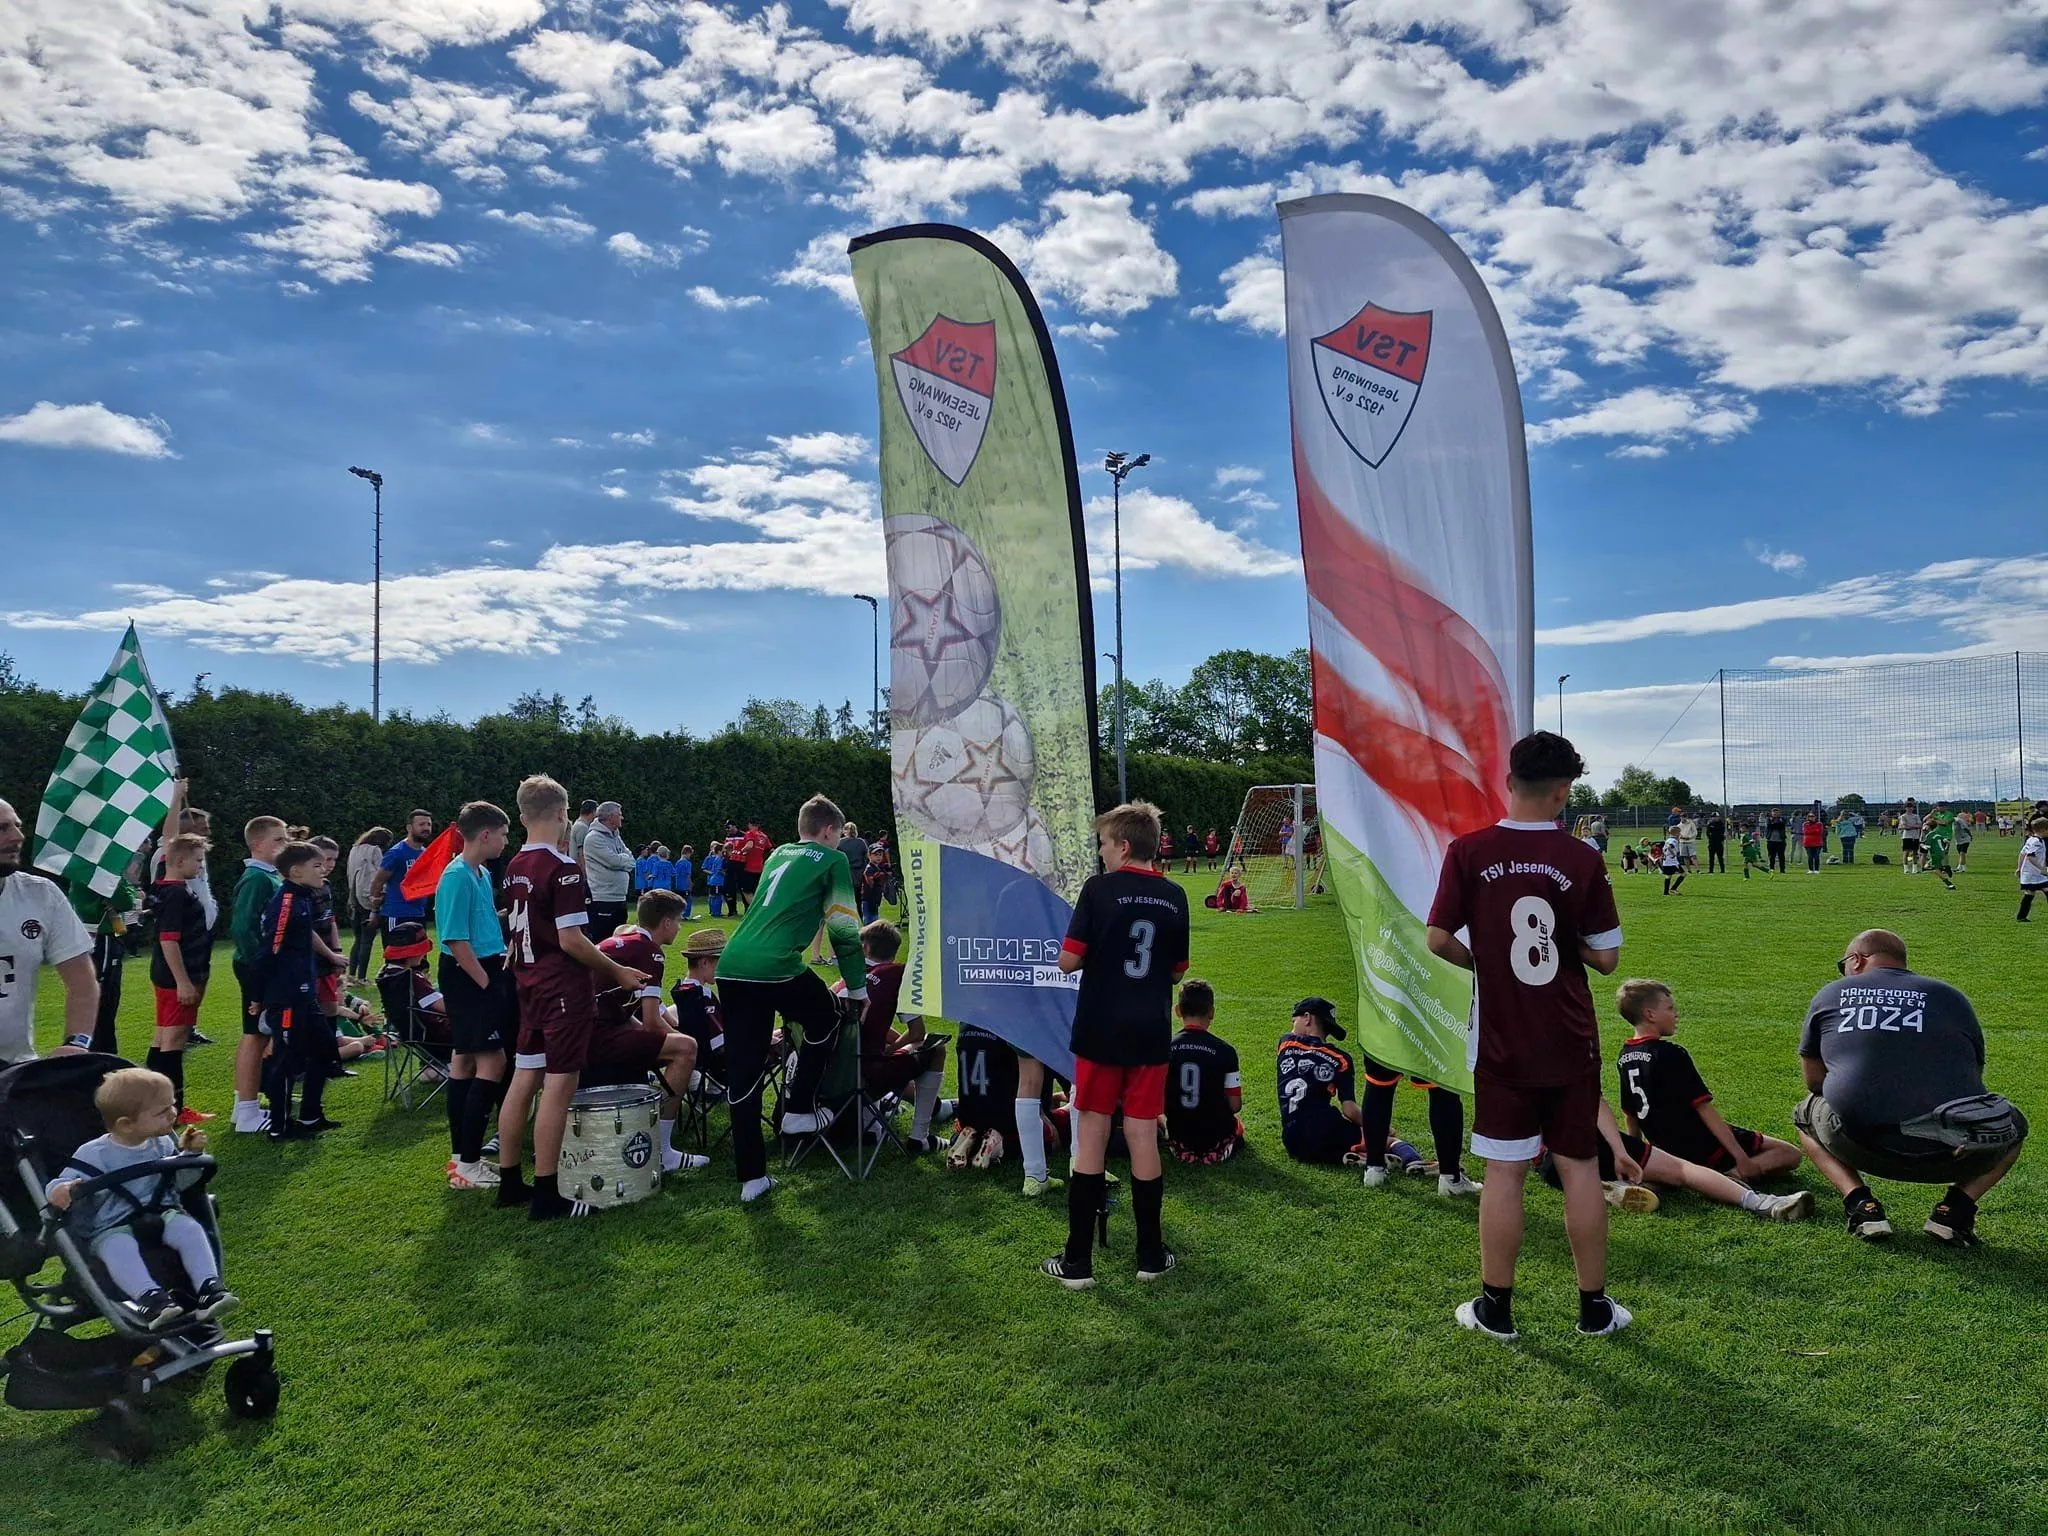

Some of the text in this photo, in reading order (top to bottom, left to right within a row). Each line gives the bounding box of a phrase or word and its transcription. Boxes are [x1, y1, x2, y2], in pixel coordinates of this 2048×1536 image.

[762, 860, 793, 907] 1
[1480, 860, 1573, 892] TSV Jesenwang
[1116, 895, 1179, 914] TSV JESENWANG
[1123, 919, 1157, 979] 3
[1510, 895, 1560, 986] 8
[1839, 996, 1926, 1009] PFINGSTEN
[1840, 987, 1928, 1000] MAMMENDORF
[1837, 1005, 1923, 1033] 2024
[960, 1049, 990, 1096] 14
[1181, 1061, 1200, 1110] 9
[1628, 1068, 1650, 1120] 5
